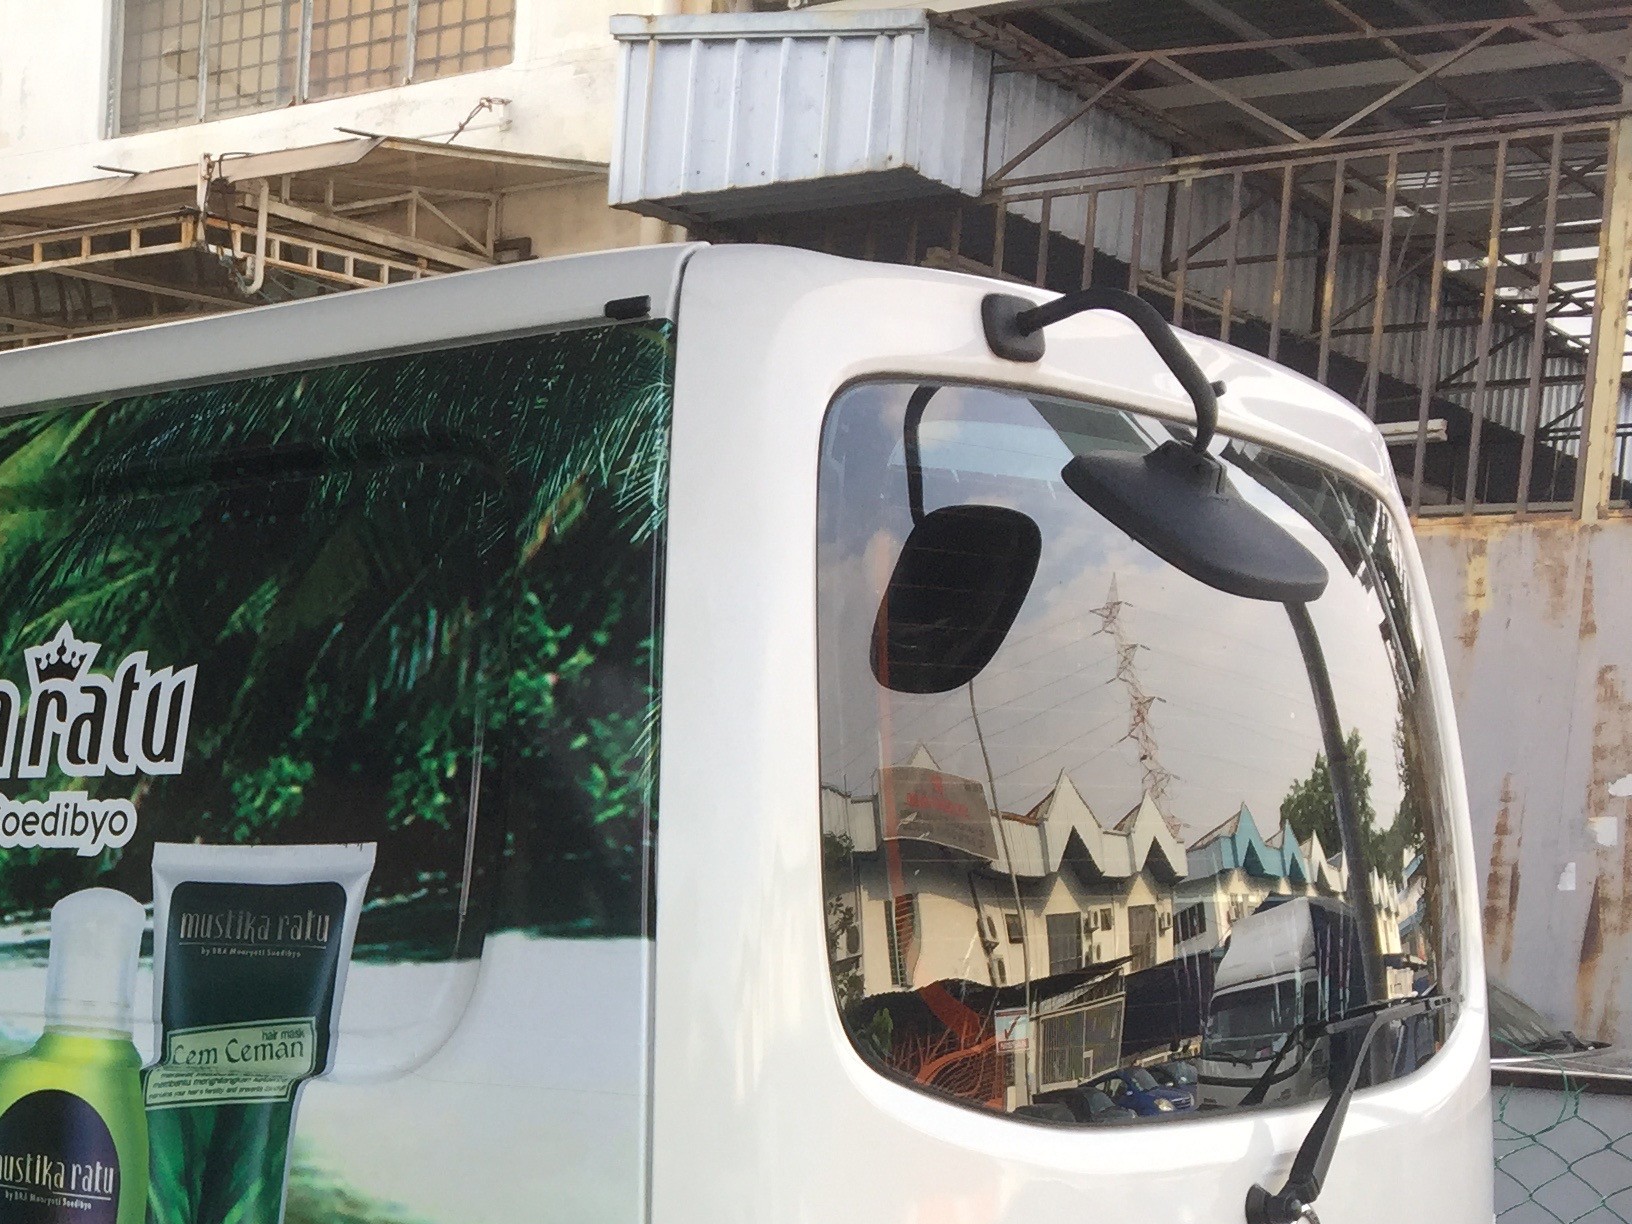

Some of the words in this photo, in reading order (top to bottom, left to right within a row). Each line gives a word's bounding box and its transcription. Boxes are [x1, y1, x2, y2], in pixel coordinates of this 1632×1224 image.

[28, 662, 186, 767] ratu
[179, 910, 270, 943] mustika
[277, 910, 330, 942] ratu
[172, 1044, 218, 1065] Cem
[225, 1038, 304, 1063] Ceman
[71, 1161, 114, 1194] ratu
